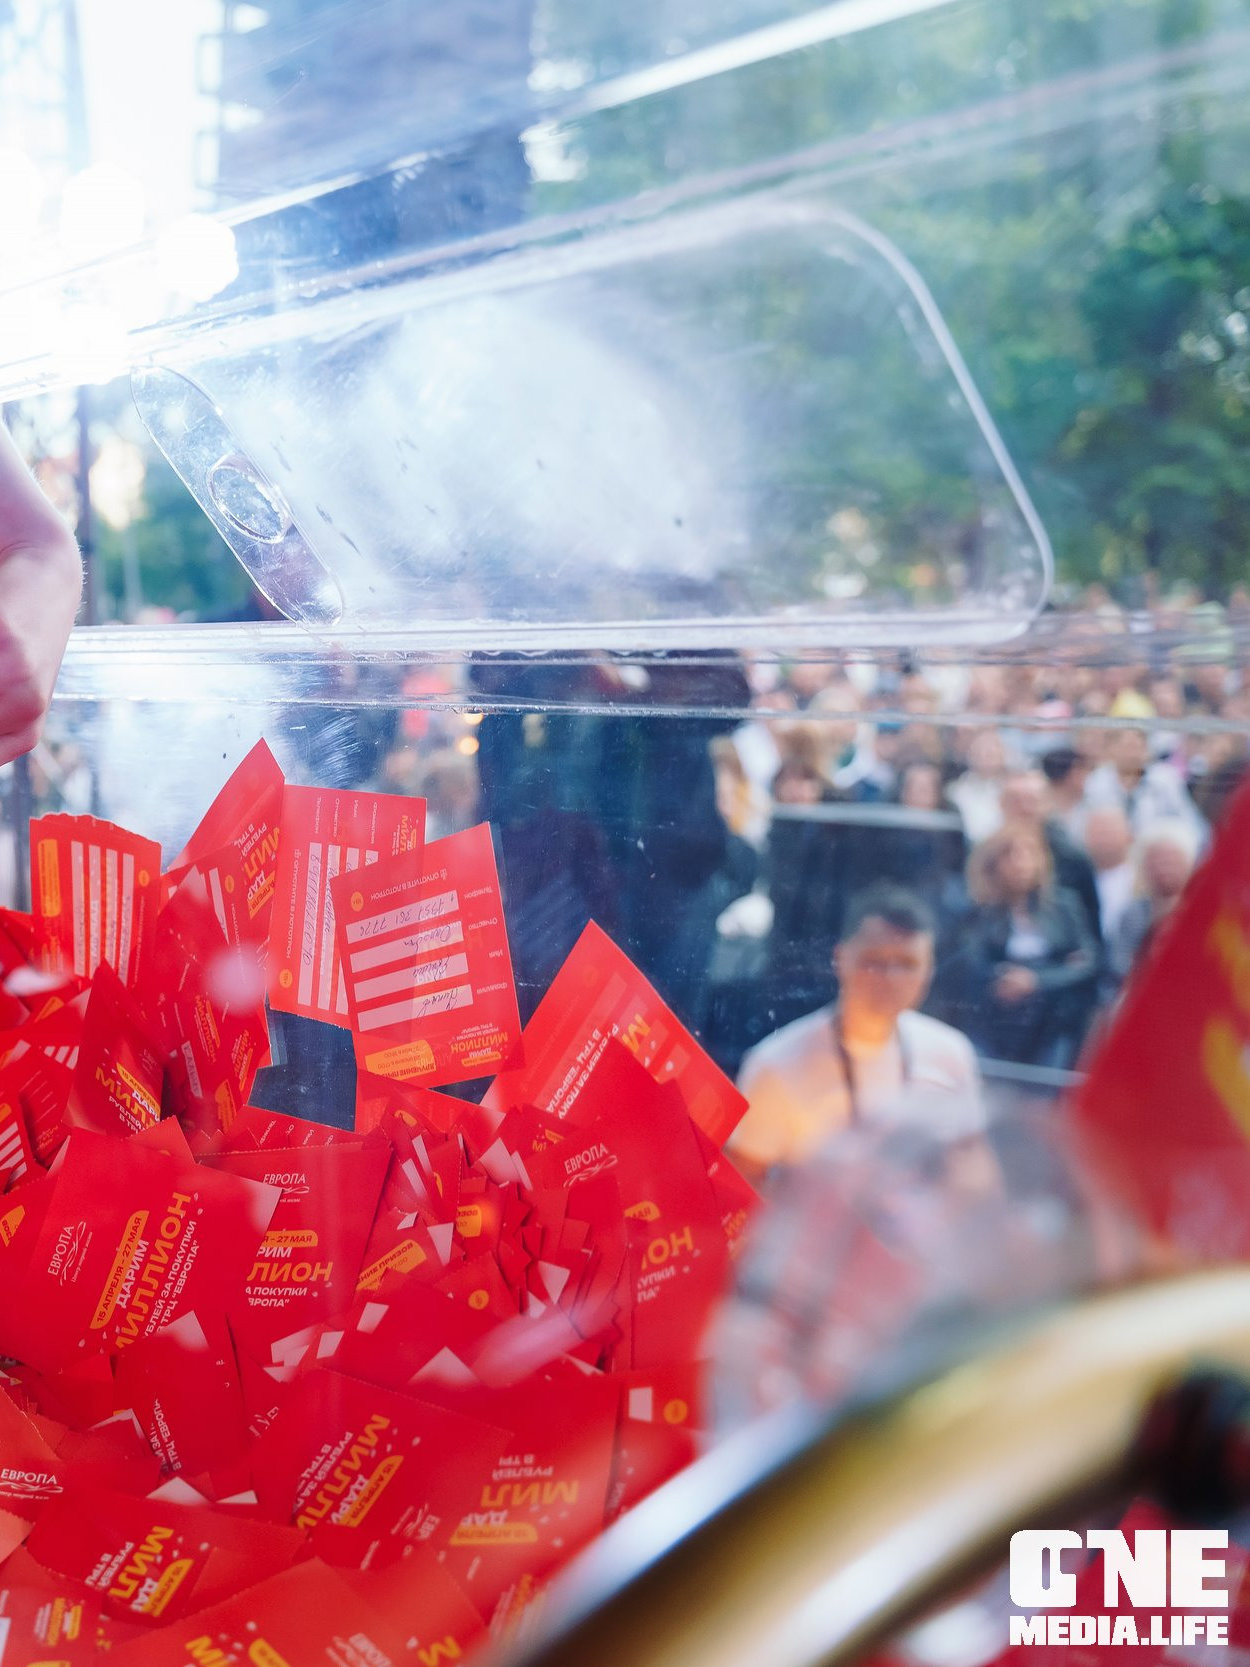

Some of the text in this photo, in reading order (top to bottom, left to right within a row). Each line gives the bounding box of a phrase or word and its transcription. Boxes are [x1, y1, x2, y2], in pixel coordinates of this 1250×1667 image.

[312, 796, 321, 833] Телефон
[331, 798, 340, 836] Отчество
[369, 801, 378, 844] Фамилия
[239, 821, 268, 858] РУБЛЕЙ
[289, 859, 299, 904] ОПУСТИТЕ
[369, 884, 402, 900] ЛОТОТРОН
[405, 871, 440, 887] ОПУСТИТЕ
[463, 885, 492, 899] Телефон
[285, 912, 295, 958] ЛОТОТРОН
[467, 917, 498, 930] Отчество
[488, 948, 503, 958] Имя
[476, 981, 507, 994] Фамилия
[449, 1031, 508, 1053] МИЛЛИОН
[574, 1028, 602, 1064] В ТРЦ
[575, 1069, 590, 1087] ЗА
[561, 1143, 610, 1174] ЕВРОПА
[262, 1173, 306, 1184] ЕВРОПА
[45, 1222, 77, 1276] ЕВРОПА
[160, 1219, 199, 1298] ЗА ПОКУПКИ
[376, 1242, 415, 1268] ПРИЗОВ
[96, 1215, 143, 1323] 15 АПРЕЛЯ 27 МАЯ
[112, 1238, 153, 1309] ДАРИМ
[253, 1286, 307, 1295] ПОКУПКИ
[160, 1298, 178, 1325] ТРЦ
[300, 1442, 332, 1480] В ТРЦ
[313, 1429, 353, 1482] РУБЛЕЙ
[0, 1467, 58, 1486] ЕВРОПА
